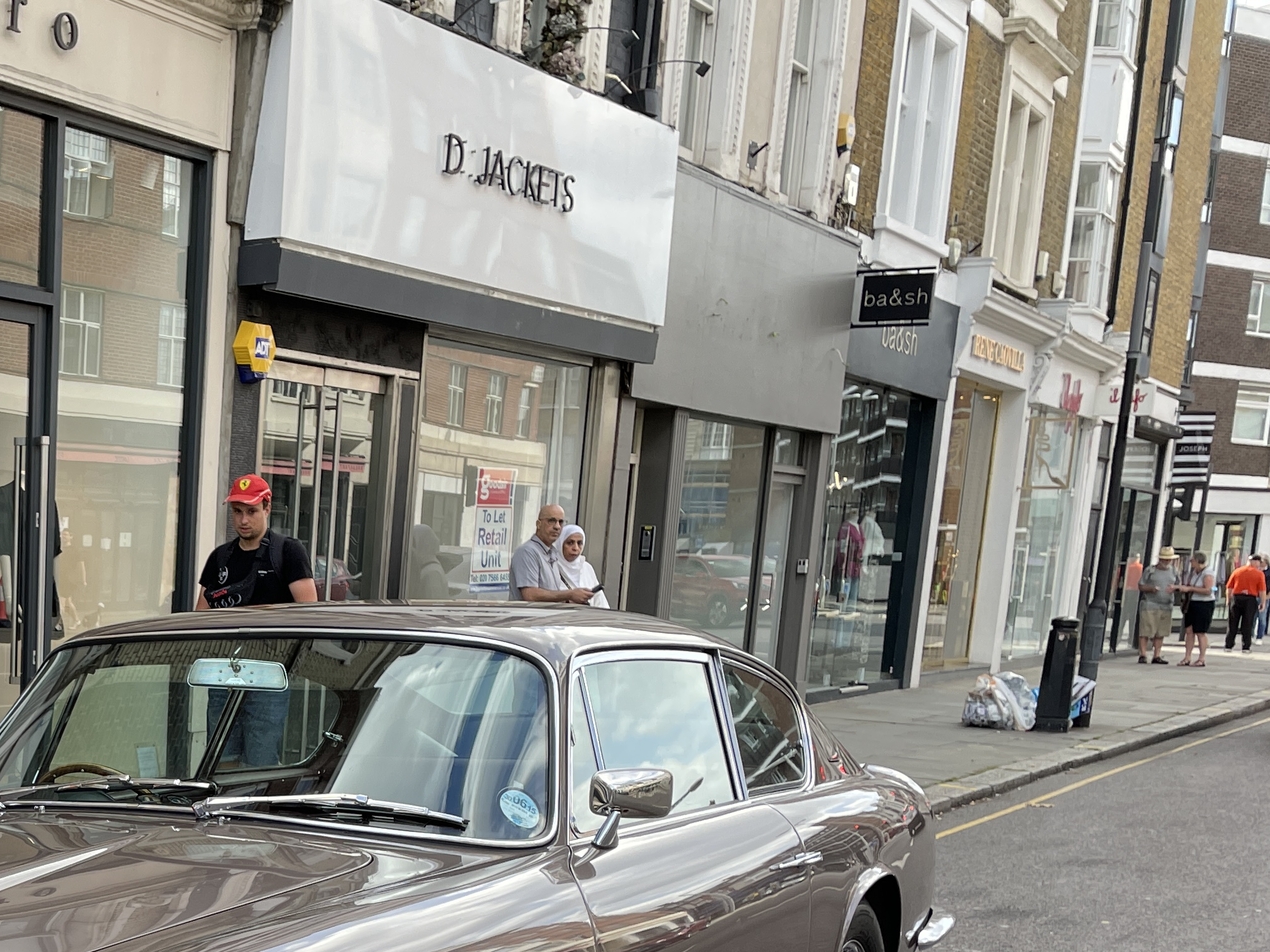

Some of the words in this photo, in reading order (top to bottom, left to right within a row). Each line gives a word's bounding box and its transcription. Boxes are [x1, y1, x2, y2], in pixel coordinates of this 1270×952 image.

[474, 146, 576, 213] JACKETS
[864, 287, 929, 307] ba&sh
[255, 340, 271, 356] ADT
[1179, 445, 1208, 453] JOSEPH
[482, 509, 491, 523] To
[494, 510, 506, 523] Let
[478, 528, 507, 546] Retail
[481, 550, 501, 568] Unit
